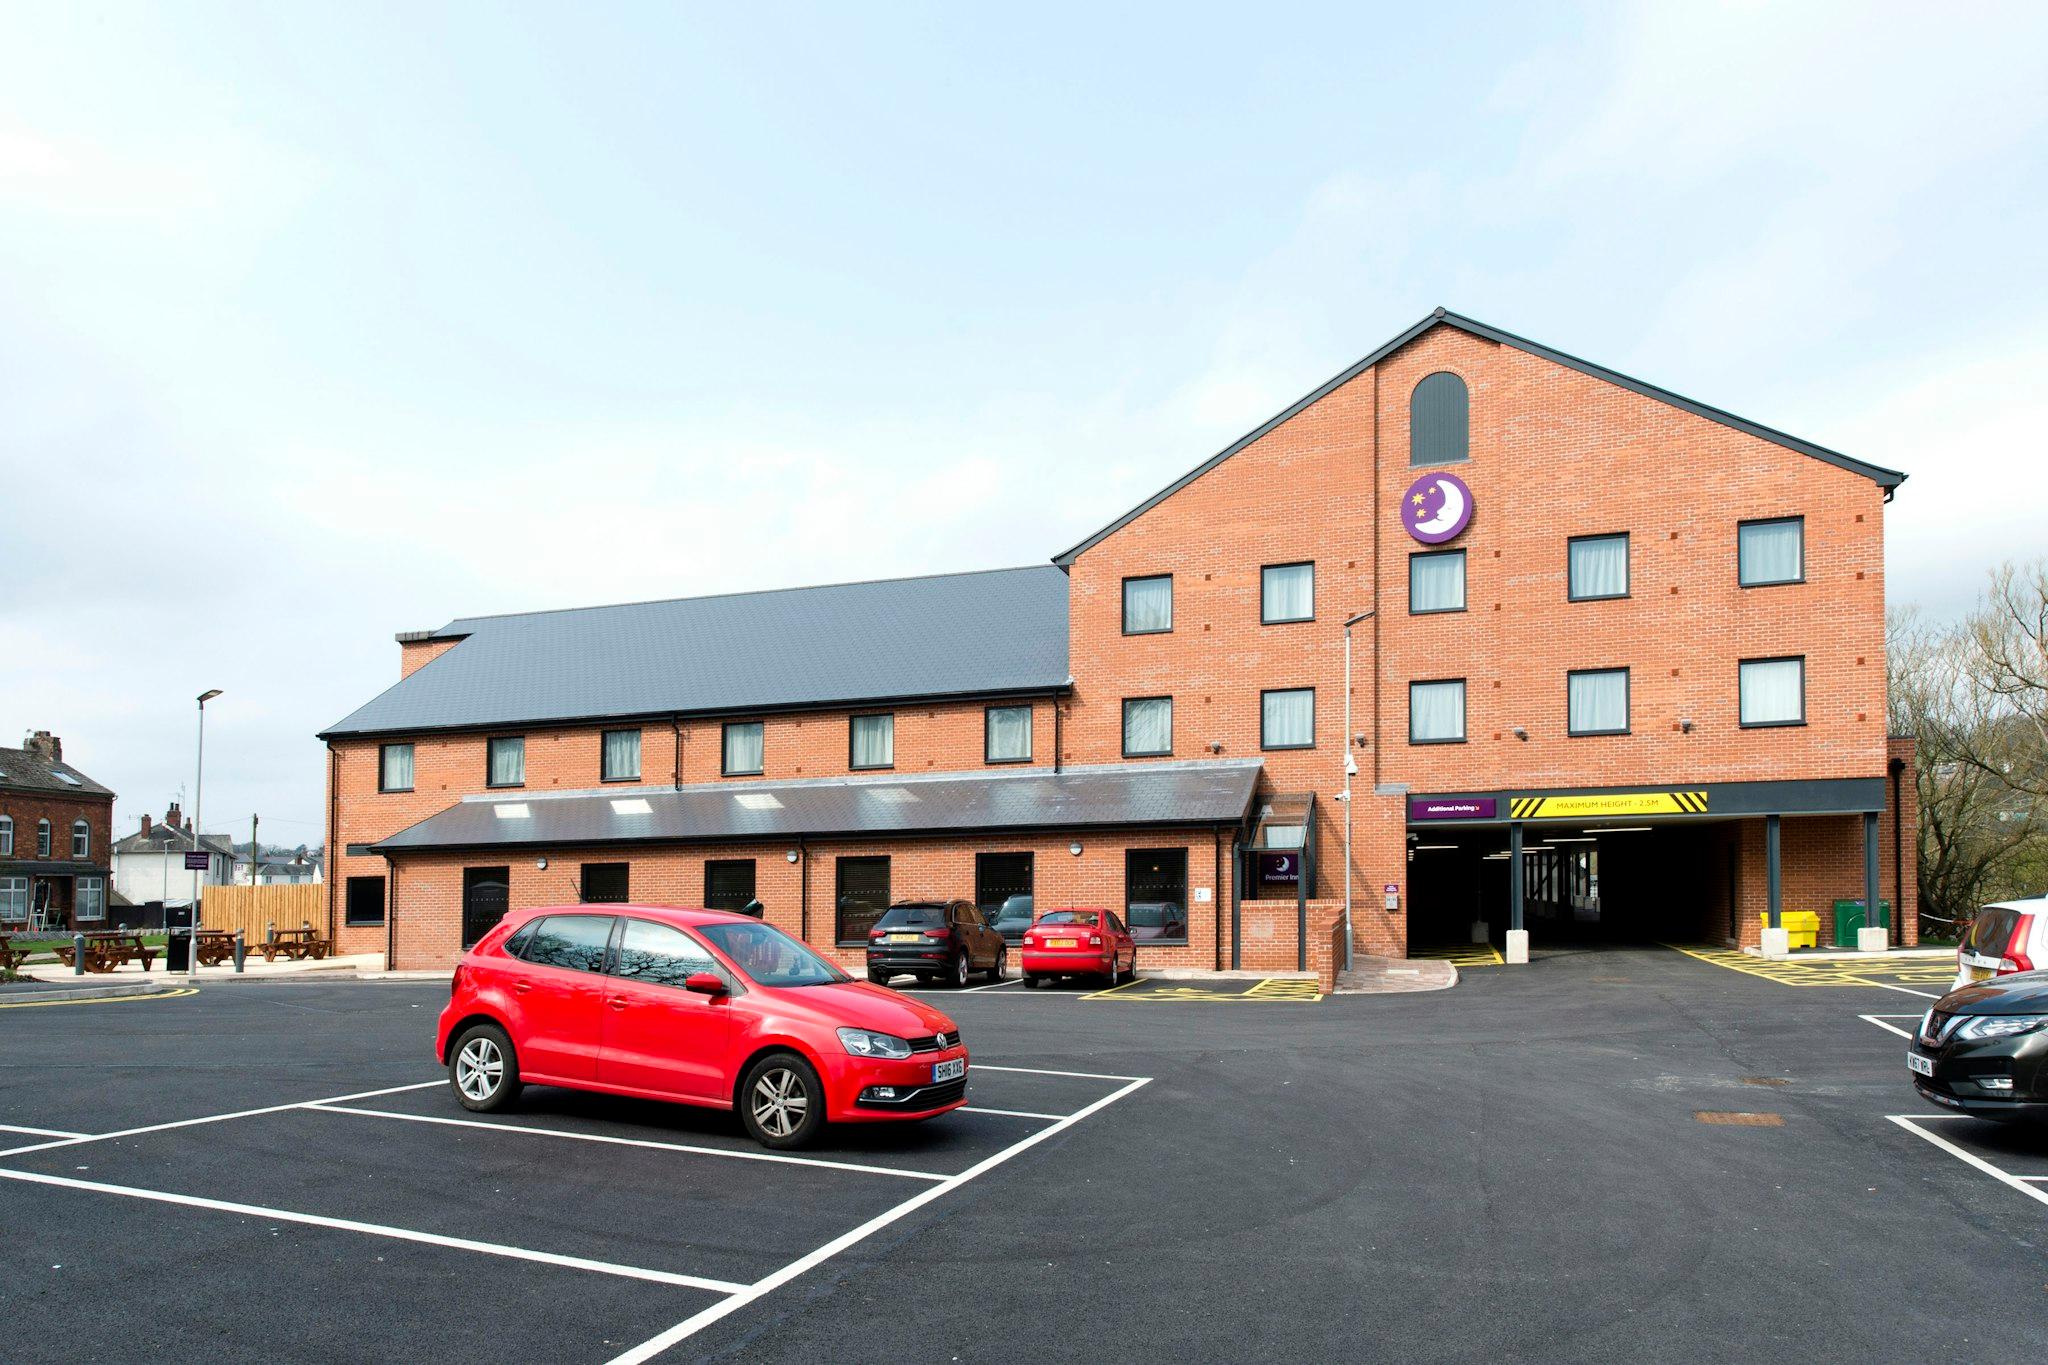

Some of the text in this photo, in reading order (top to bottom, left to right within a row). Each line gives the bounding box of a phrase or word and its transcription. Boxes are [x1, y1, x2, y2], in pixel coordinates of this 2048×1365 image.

[1556, 801, 1599, 809] MAXIMUM
[1600, 800, 1632, 808] HEIGHT
[1639, 799, 1659, 807] 2.5M
